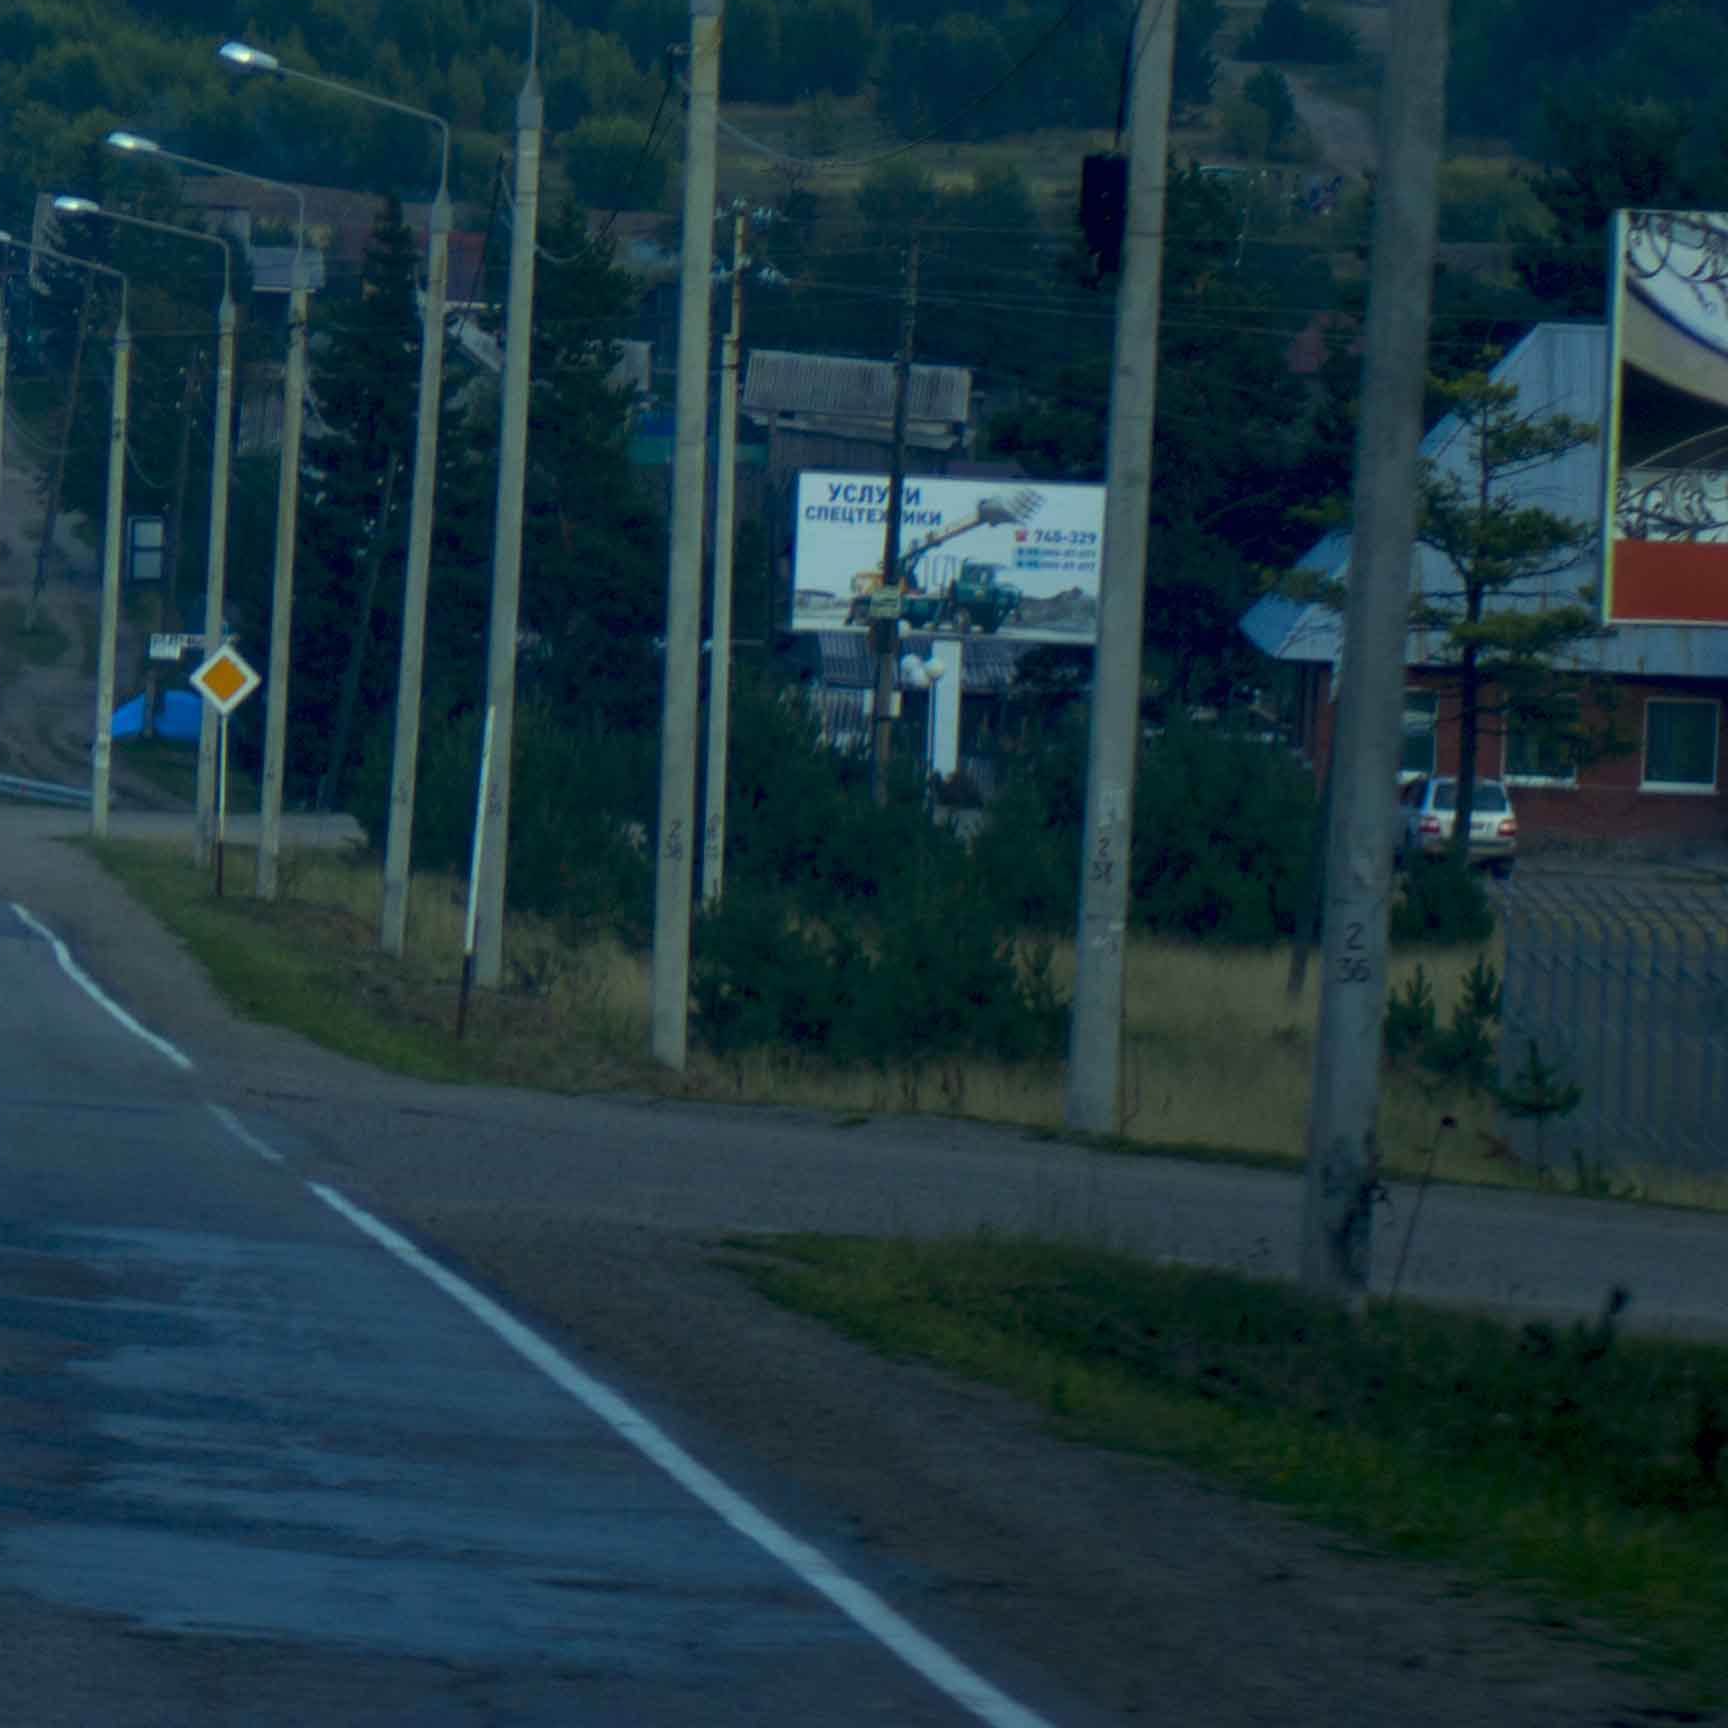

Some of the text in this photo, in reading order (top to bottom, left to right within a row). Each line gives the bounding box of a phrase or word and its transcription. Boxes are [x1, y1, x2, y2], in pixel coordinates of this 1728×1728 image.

[828, 482, 921, 505] УСЛУИ
[805, 505, 943, 525] СПЕЦТЕХИКИ
[1344, 922, 1365, 950] 2
